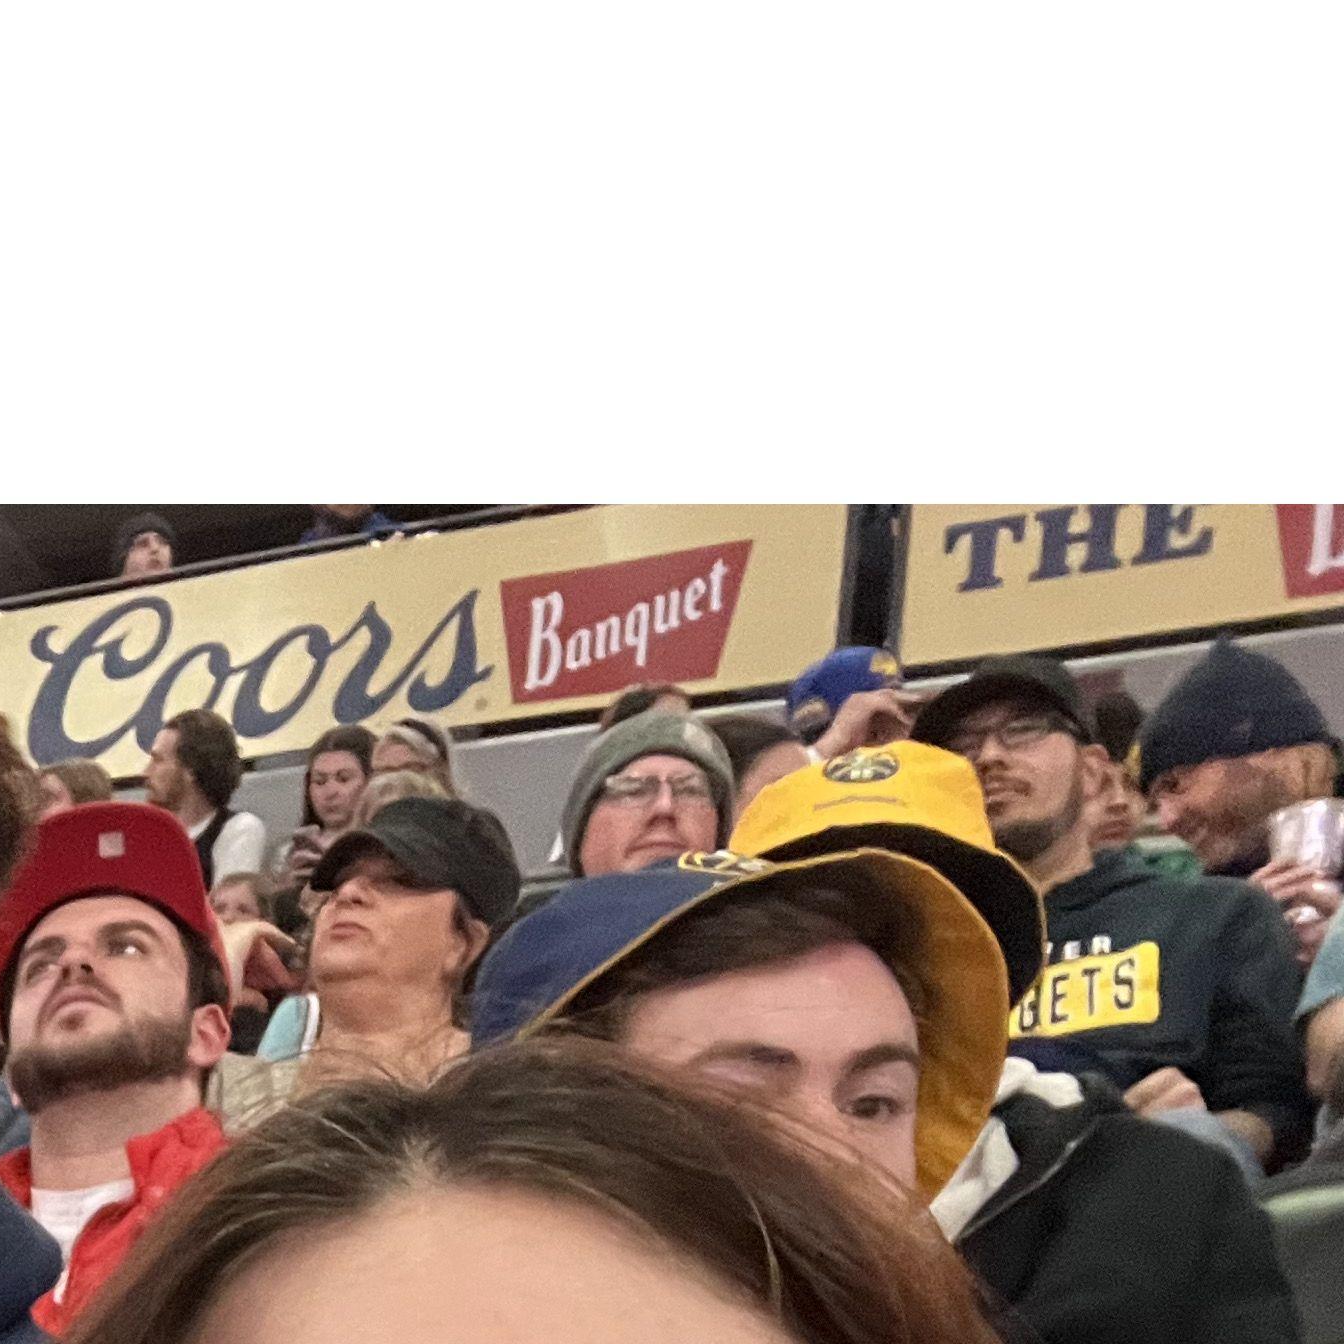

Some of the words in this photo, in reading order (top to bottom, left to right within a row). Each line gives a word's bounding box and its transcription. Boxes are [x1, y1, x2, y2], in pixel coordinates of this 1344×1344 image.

[944, 504, 1214, 593] THE
[27, 596, 496, 768] Coors
[524, 558, 729, 692] Banquet
